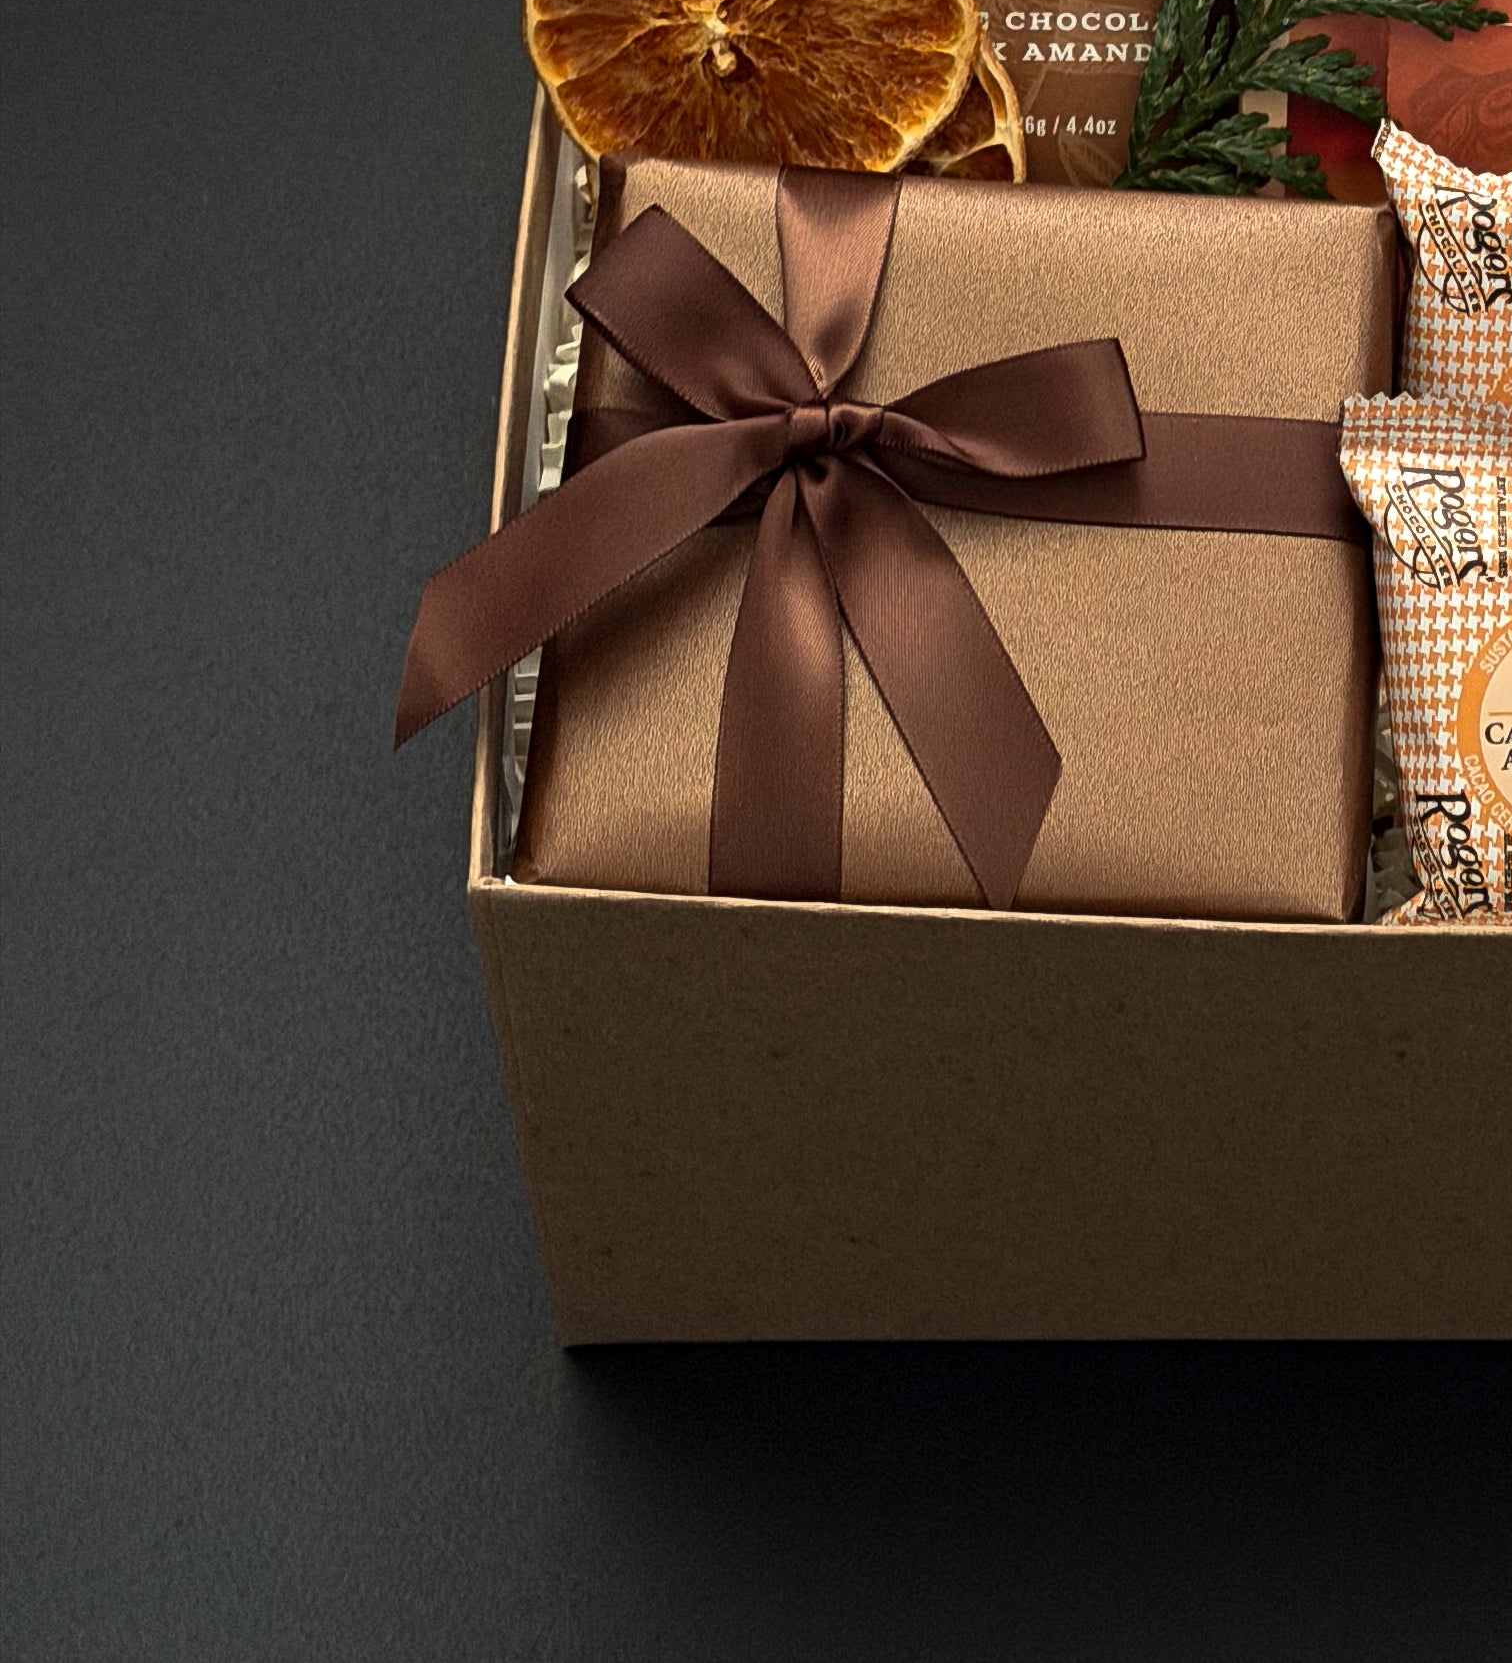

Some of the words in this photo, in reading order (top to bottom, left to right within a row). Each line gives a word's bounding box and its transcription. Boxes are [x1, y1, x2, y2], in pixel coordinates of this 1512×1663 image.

[1005, 11, 1158, 32] CHOCOL
[1020, 115, 1046, 137] 6g
[1066, 115, 1116, 136] 4.4oz
[1392, 484, 1453, 587] CHOCOLATES
[1464, 754, 1495, 805] CACAO
